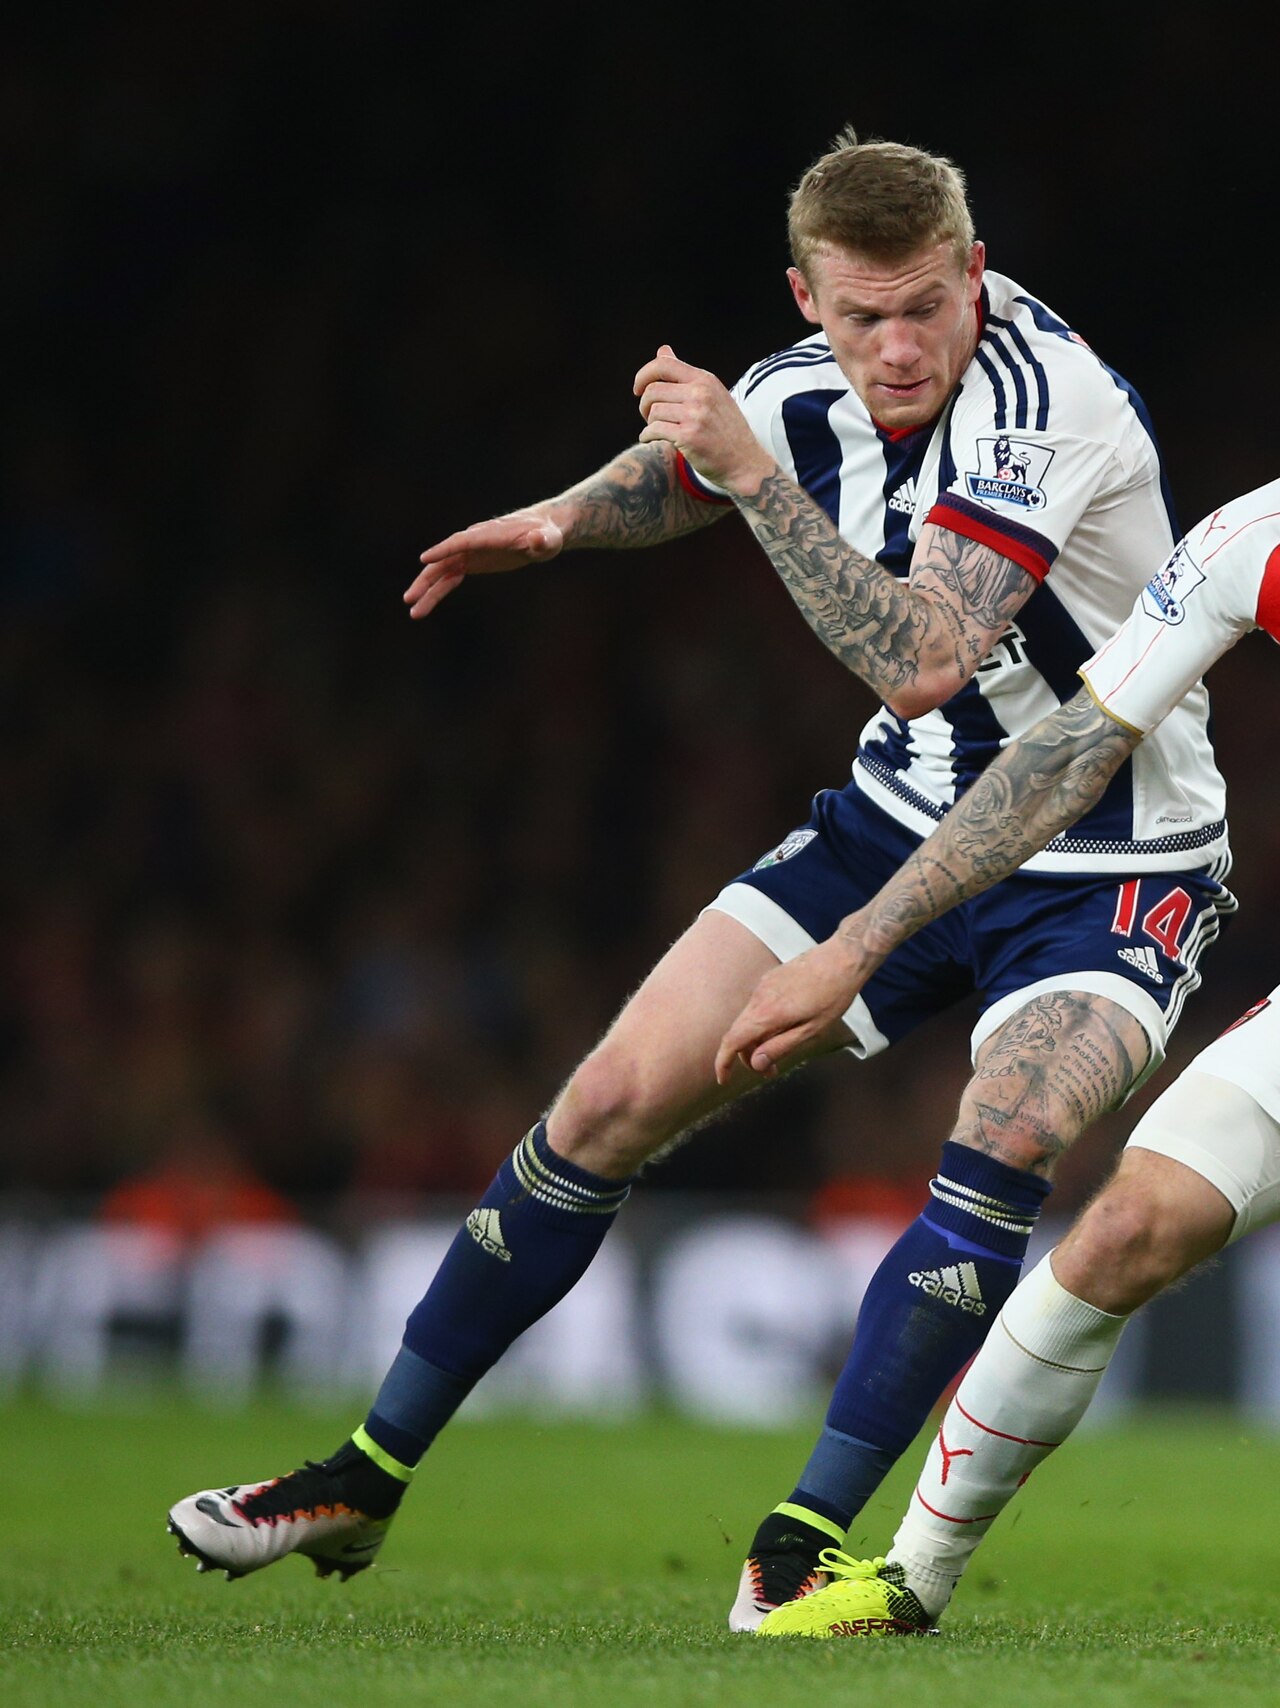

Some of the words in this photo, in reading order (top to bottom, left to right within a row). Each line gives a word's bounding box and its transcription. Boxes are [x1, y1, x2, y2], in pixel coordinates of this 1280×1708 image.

[975, 489, 1003, 499] PREMIER
[977, 480, 1027, 498] BARCLAYS
[1111, 878, 1192, 962] 14
[1117, 948, 1164, 985] adidas
[465, 1208, 512, 1262] didas
[907, 1272, 987, 1315] adidas
